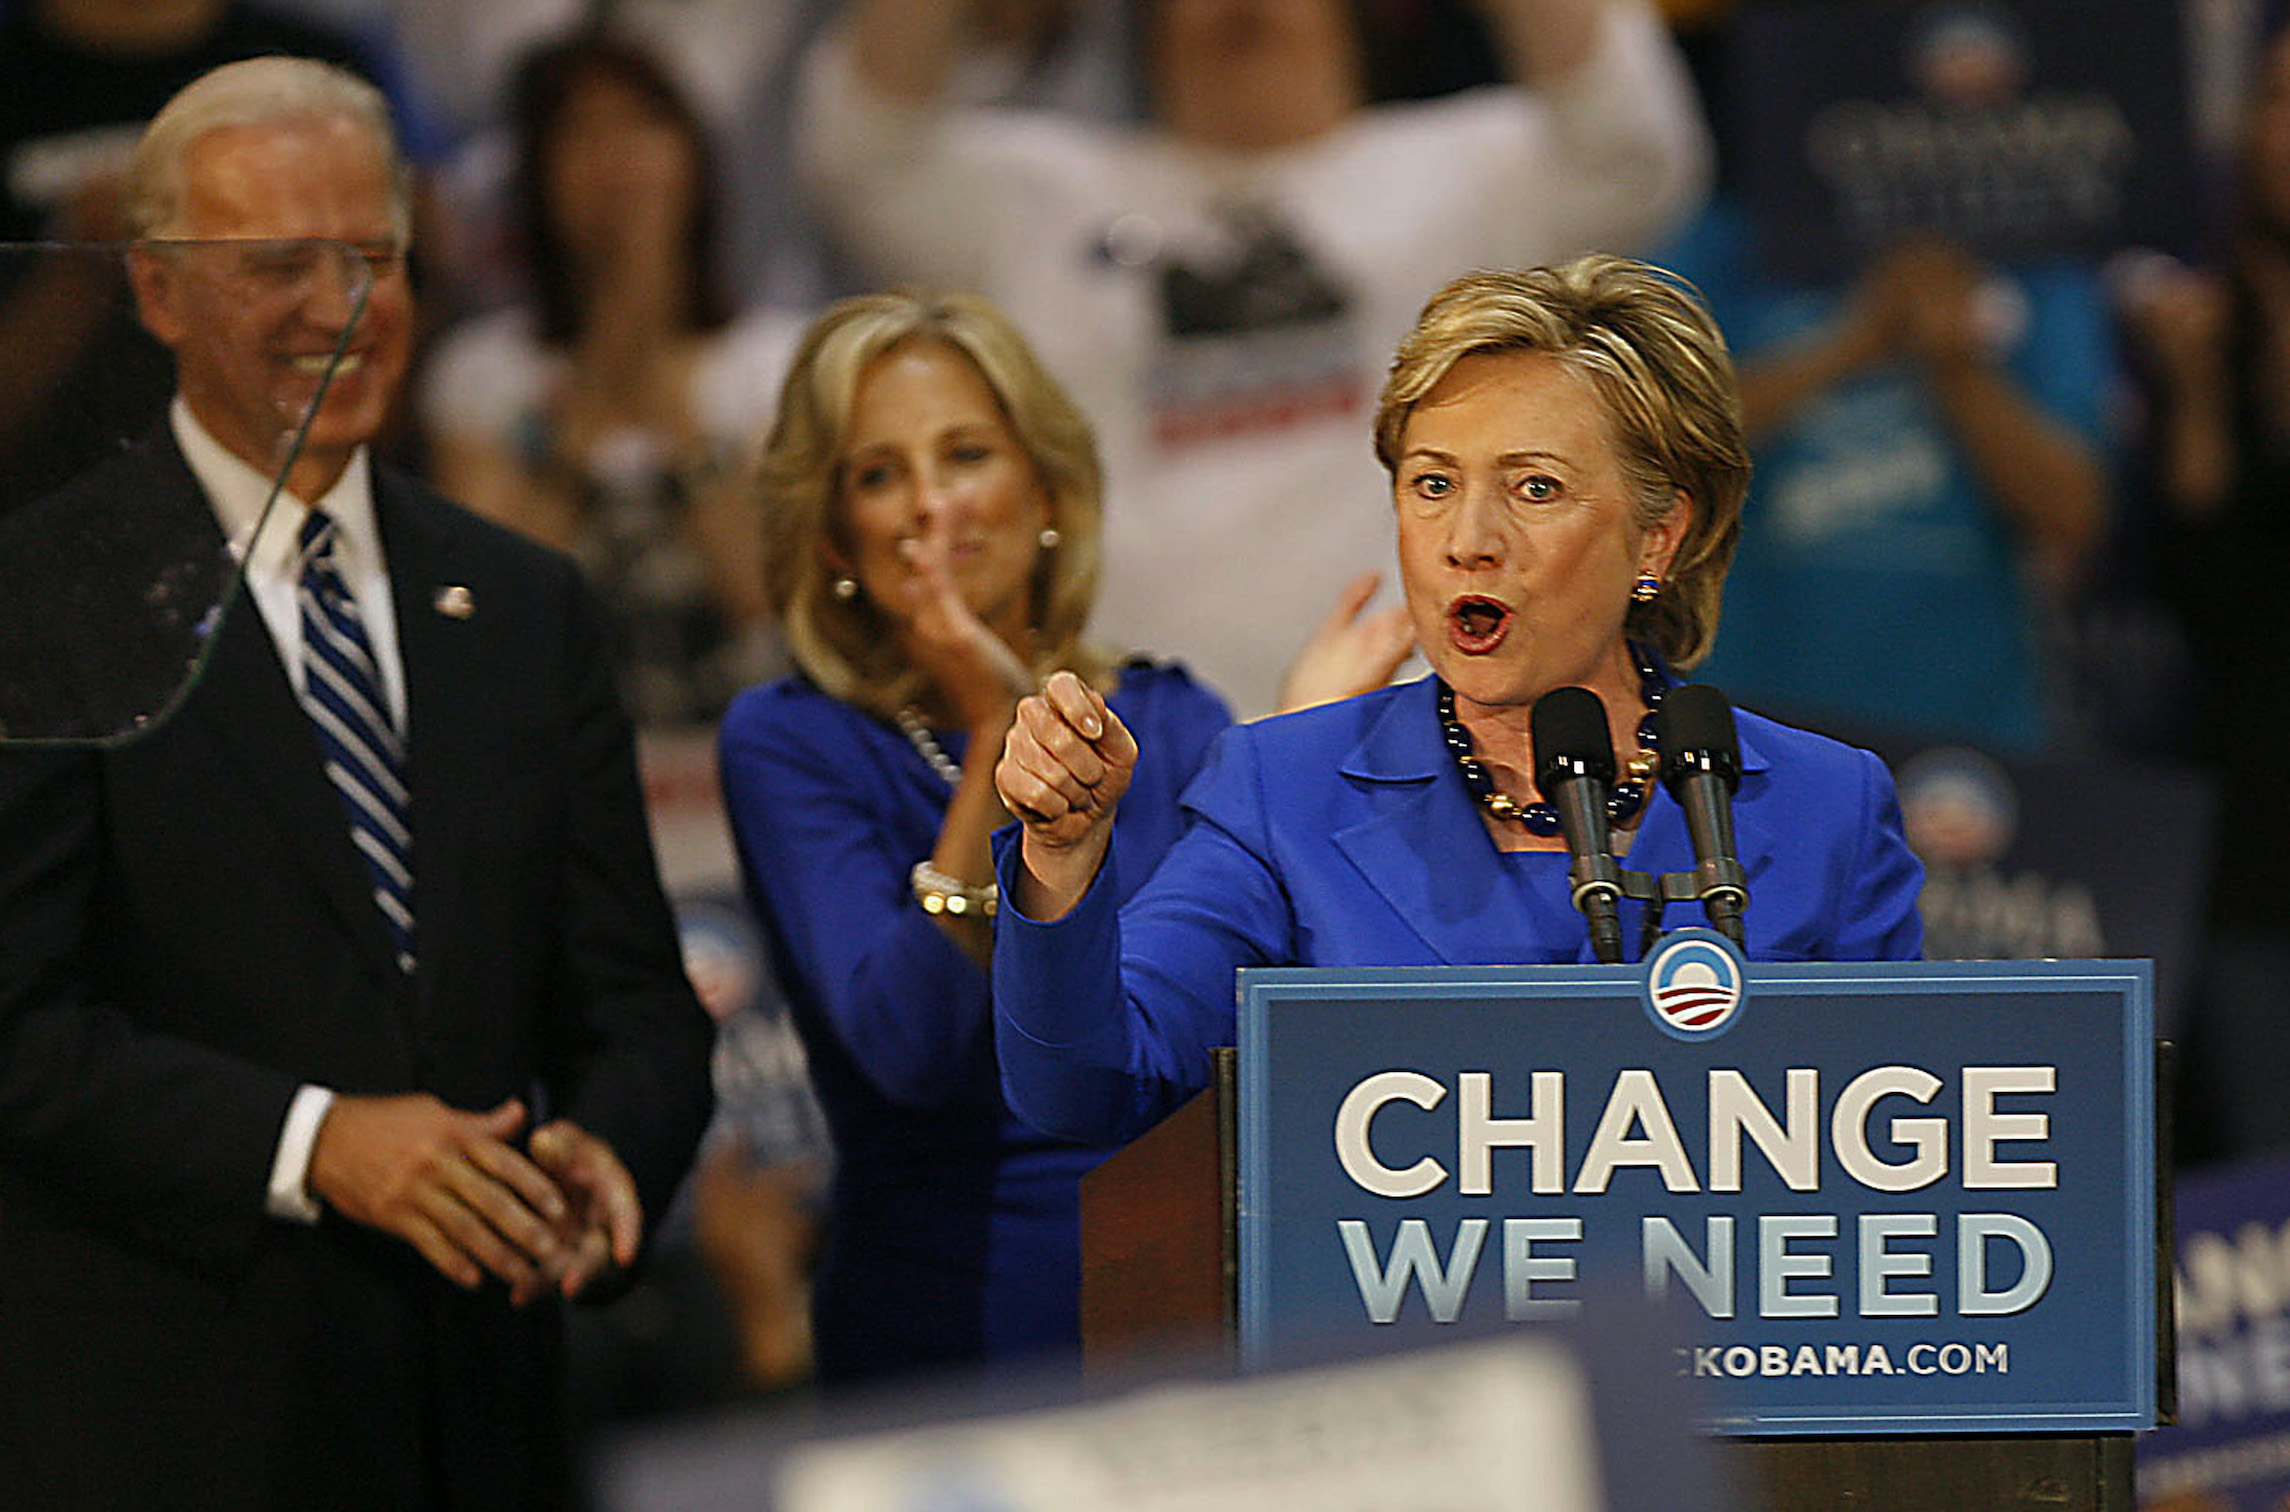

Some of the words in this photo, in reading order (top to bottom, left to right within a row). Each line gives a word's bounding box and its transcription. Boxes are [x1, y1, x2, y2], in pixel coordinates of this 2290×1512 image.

[1334, 1066, 2058, 1197] CHANGE
[1338, 1218, 1584, 1323] WE
[1642, 1213, 2054, 1319] NEED
[1675, 1343, 2010, 1378] KOBAMA.COM
